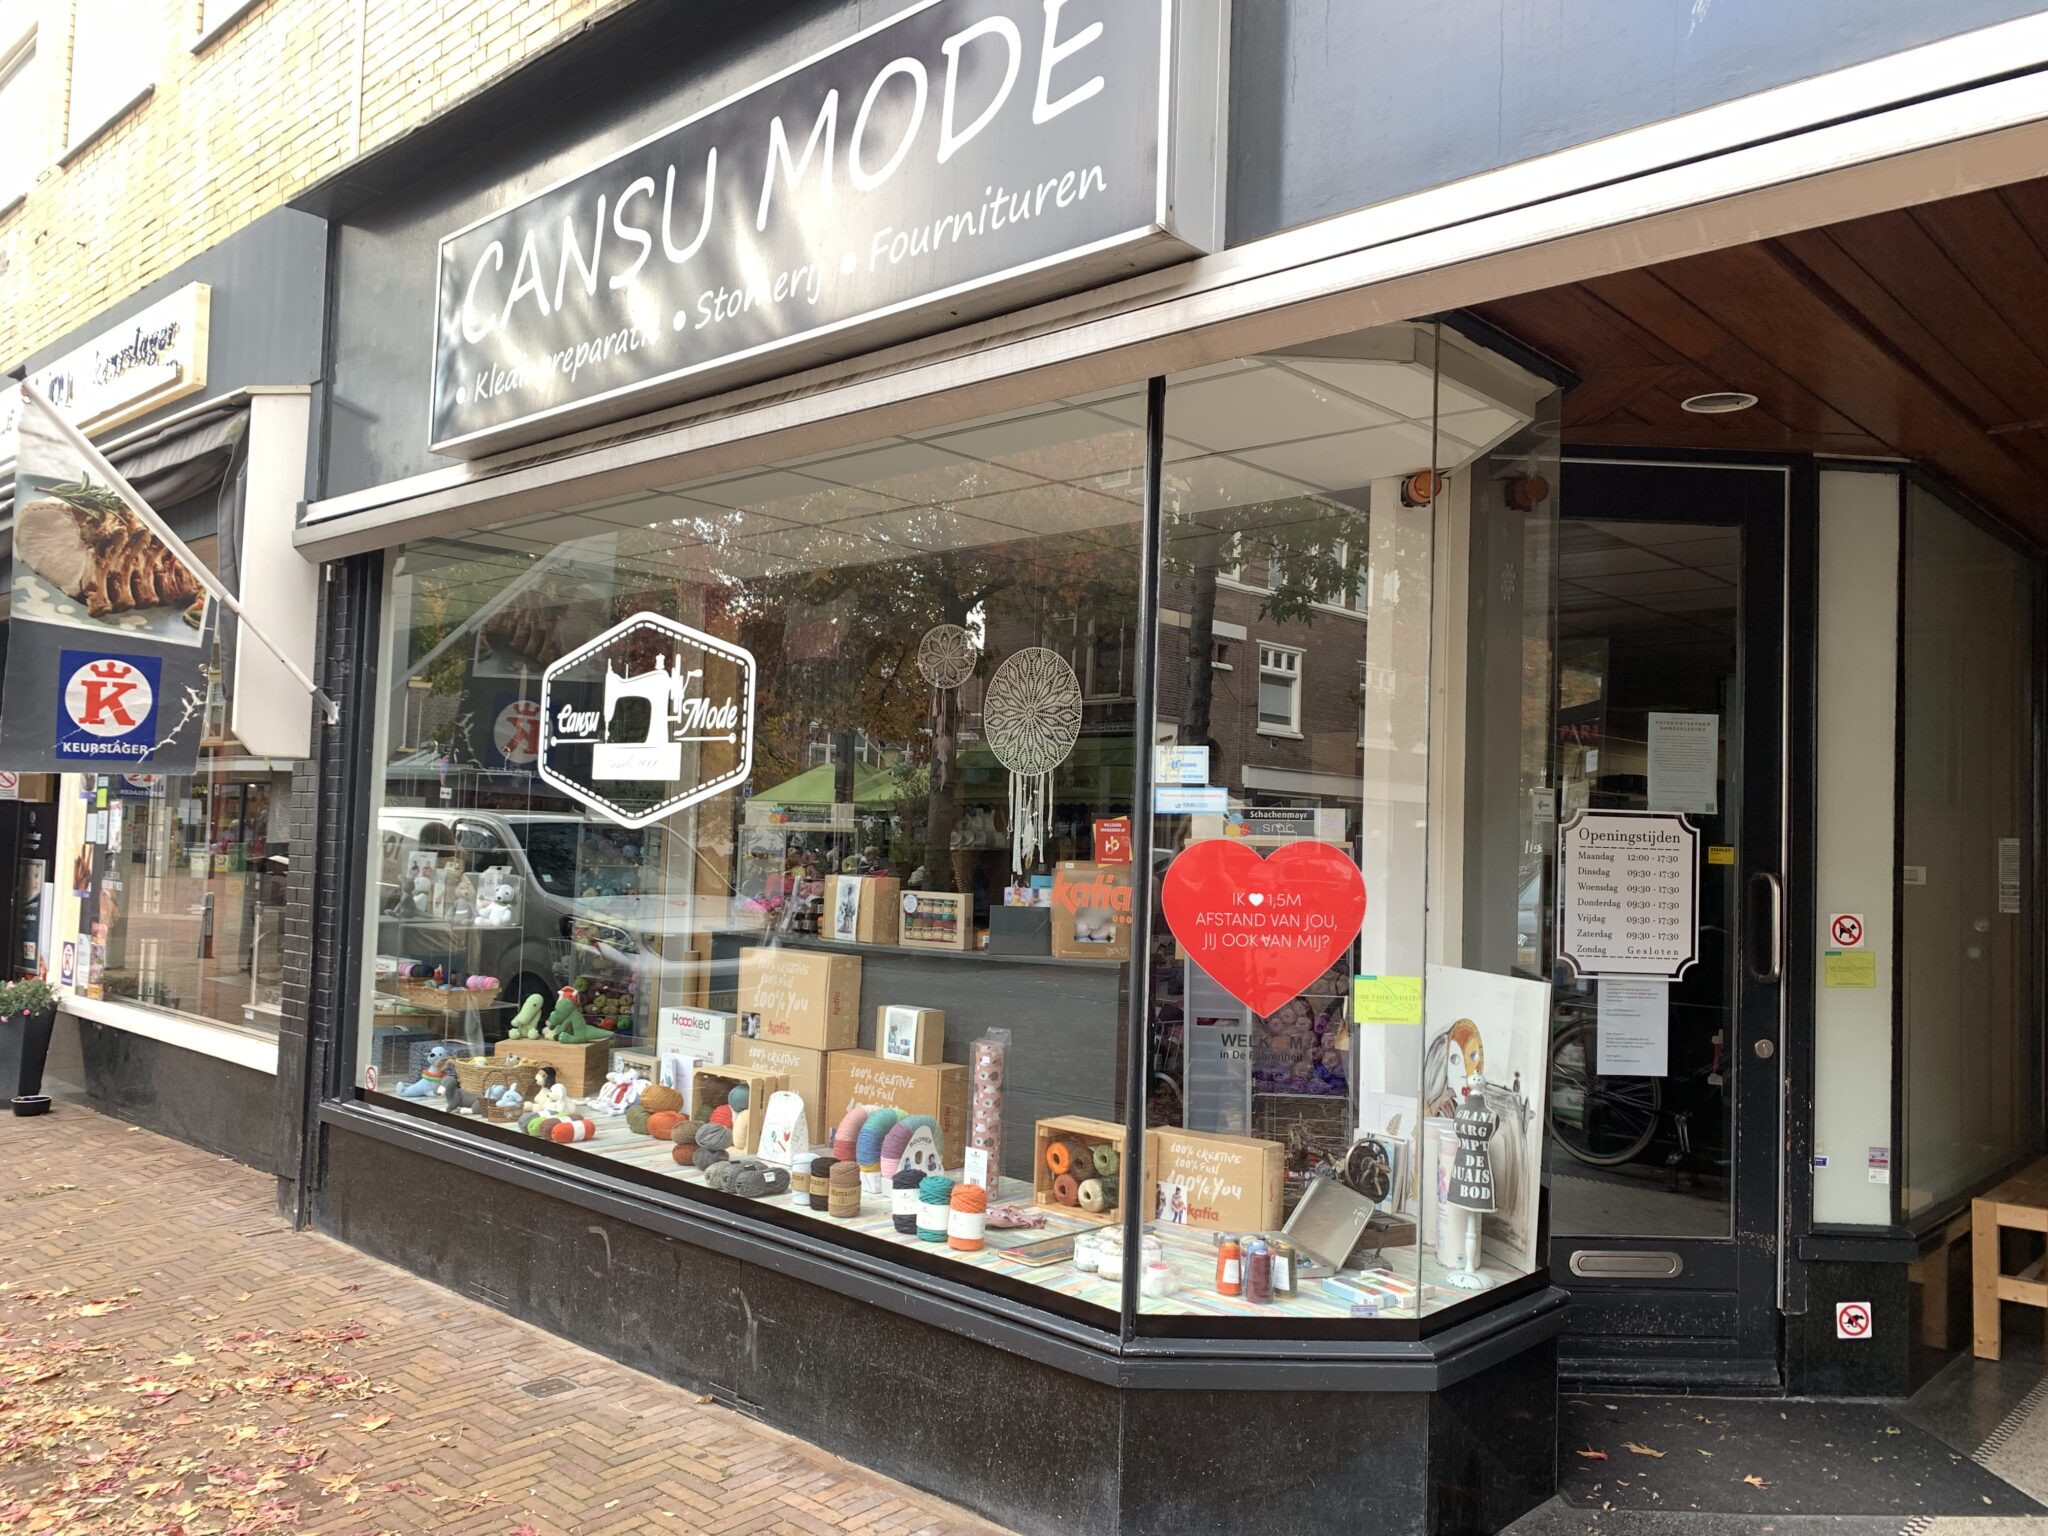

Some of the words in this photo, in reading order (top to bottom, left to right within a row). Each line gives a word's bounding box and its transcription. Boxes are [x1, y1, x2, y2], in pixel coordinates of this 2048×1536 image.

[462, 147, 716, 344] CANSU
[757, 0, 1105, 233] MODE
[474, 324, 660, 403] Kledreparat
[869, 165, 1107, 273] Fournituren
[78, 680, 138, 726] K
[557, 703, 600, 737] Cansu
[674, 696, 738, 736] Mode
[63, 742, 148, 756] KEURSLAGER
[1249, 810, 1308, 820] Schachenmayr
[1262, 823, 1296, 833] smc
[1579, 827, 1680, 846] Openingstijden
[1578, 852, 1615, 862] Maandag
[1657, 855, 1679, 863] 17:30
[1578, 867, 1611, 878] Dinsdag
[1627, 870, 1651, 878] 09:30
[1658, 871, 1680, 879] 17:30
[1577, 882, 1618, 893] Woensdag
[1627, 885, 1651, 893] 09:30
[1658, 886, 1680, 894] 17:30
[1232, 893, 1245, 906] IK
[1267, 893, 1302, 909] 1,5M
[1577, 898, 1621, 909] Donderdag
[1626, 901, 1650, 909] 09:30
[1658, 902, 1679, 910] 17:30
[1195, 912, 1266, 927] AFSTAND
[1270, 914, 1300, 927] VAN
[1303, 914, 1337, 931] JOU,
[1577, 913, 1606, 924] Vrijdag
[1626, 916, 1650, 924] 09:30
[1658, 917, 1679, 925] 17:30
[1202, 932, 1217, 950] JIJ
[1222, 932, 1259, 947] OOK
[1262, 934, 1292, 948] VAN
[1297, 935, 1330, 952] MIJ?
[1577, 929, 1613, 940] Zaterdag
[1658, 933, 1679, 941] 17:30
[1576, 944, 1607, 955] Zondag
[752, 985, 785, 1018] 100%
[672, 1012, 711, 1031] Hoooked
[768, 1020, 791, 1036] katia
[1221, 1033, 1303, 1050] WELKM
[1220, 1050, 1229, 1059] in
[1232, 1050, 1245, 1059] De
[850, 1065, 872, 1083] 100%
[854, 1082, 875, 1100] 100%
[1170, 1142, 1194, 1156] 100%
[1175, 1157, 1198, 1173] 100%
[1465, 1154, 1485, 1168] DE
[1460, 1184, 1491, 1200] BOD
[1187, 1203, 1219, 1221] katia
